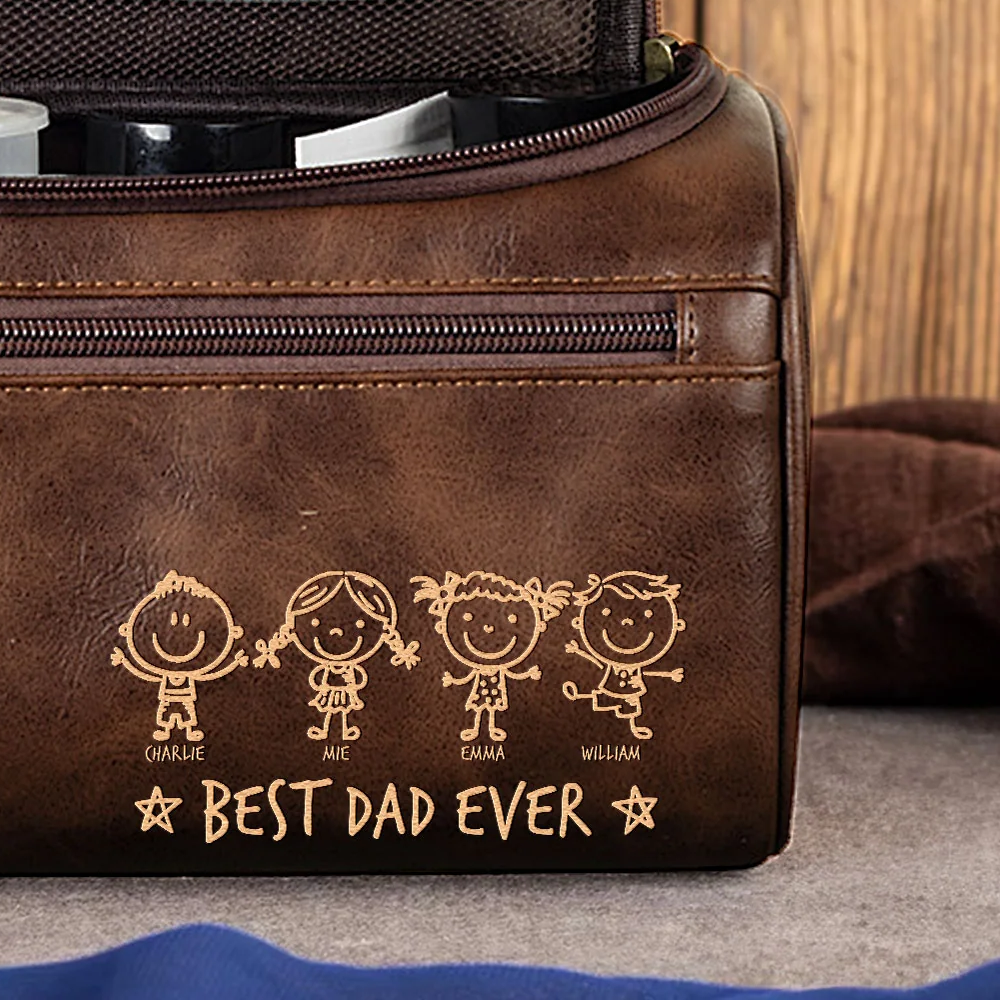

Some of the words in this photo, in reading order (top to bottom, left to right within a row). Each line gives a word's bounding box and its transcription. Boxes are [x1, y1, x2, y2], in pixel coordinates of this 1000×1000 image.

[145, 744, 205, 763] CHARLIE
[322, 745, 351, 762] MIE
[460, 744, 506, 762] EMMA
[581, 744, 641, 762] WILLIAM
[201, 777, 333, 844] BEST
[346, 782, 435, 840] DAD
[455, 780, 592, 841] EVER
